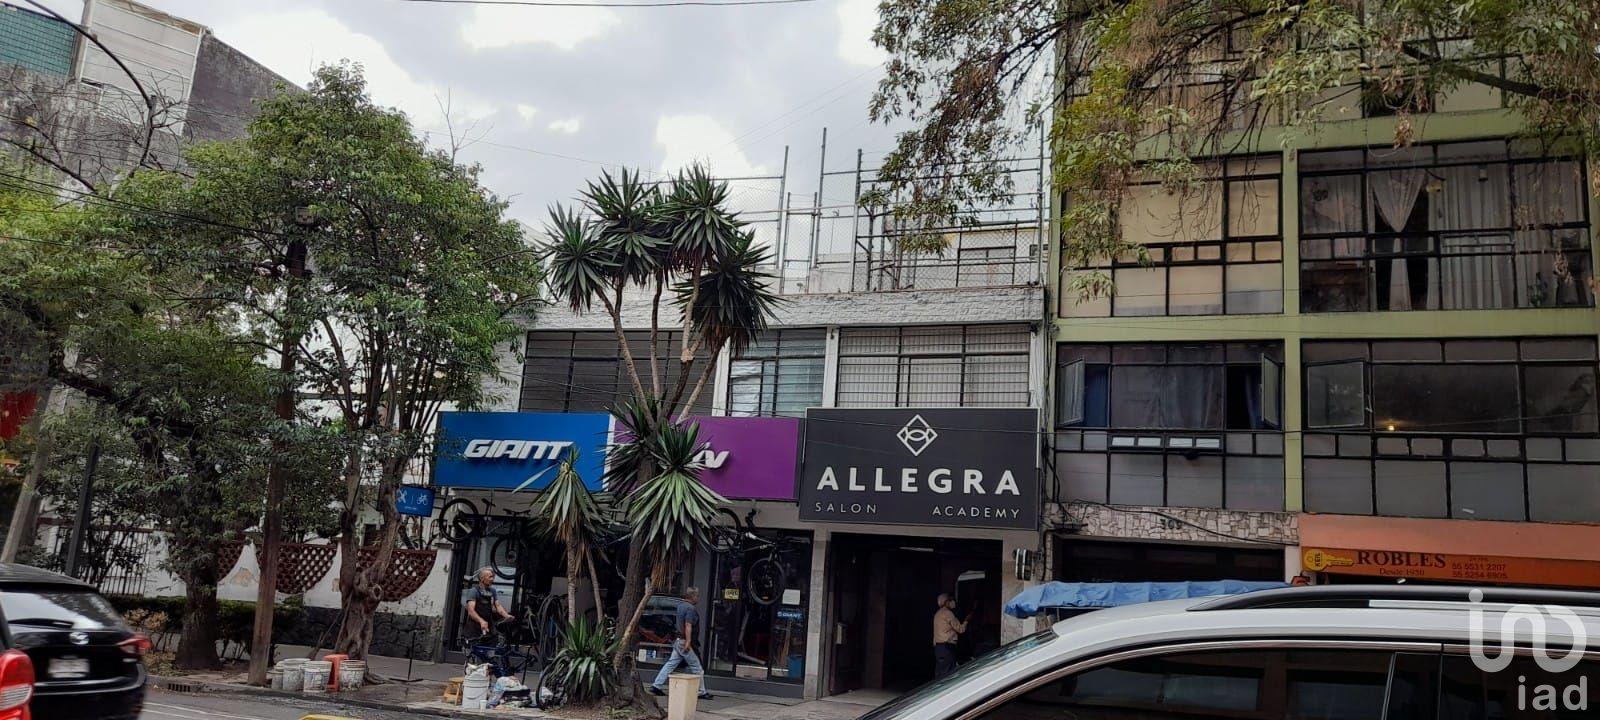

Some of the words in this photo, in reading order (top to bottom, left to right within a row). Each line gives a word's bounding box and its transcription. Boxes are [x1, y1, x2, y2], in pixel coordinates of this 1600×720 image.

[463, 439, 574, 460] GIANT
[816, 466, 1021, 496] ALLEGRA
[814, 502, 877, 514] SALON
[931, 505, 1021, 519] ACADEMY
[1357, 551, 1447, 569] ROBLES
